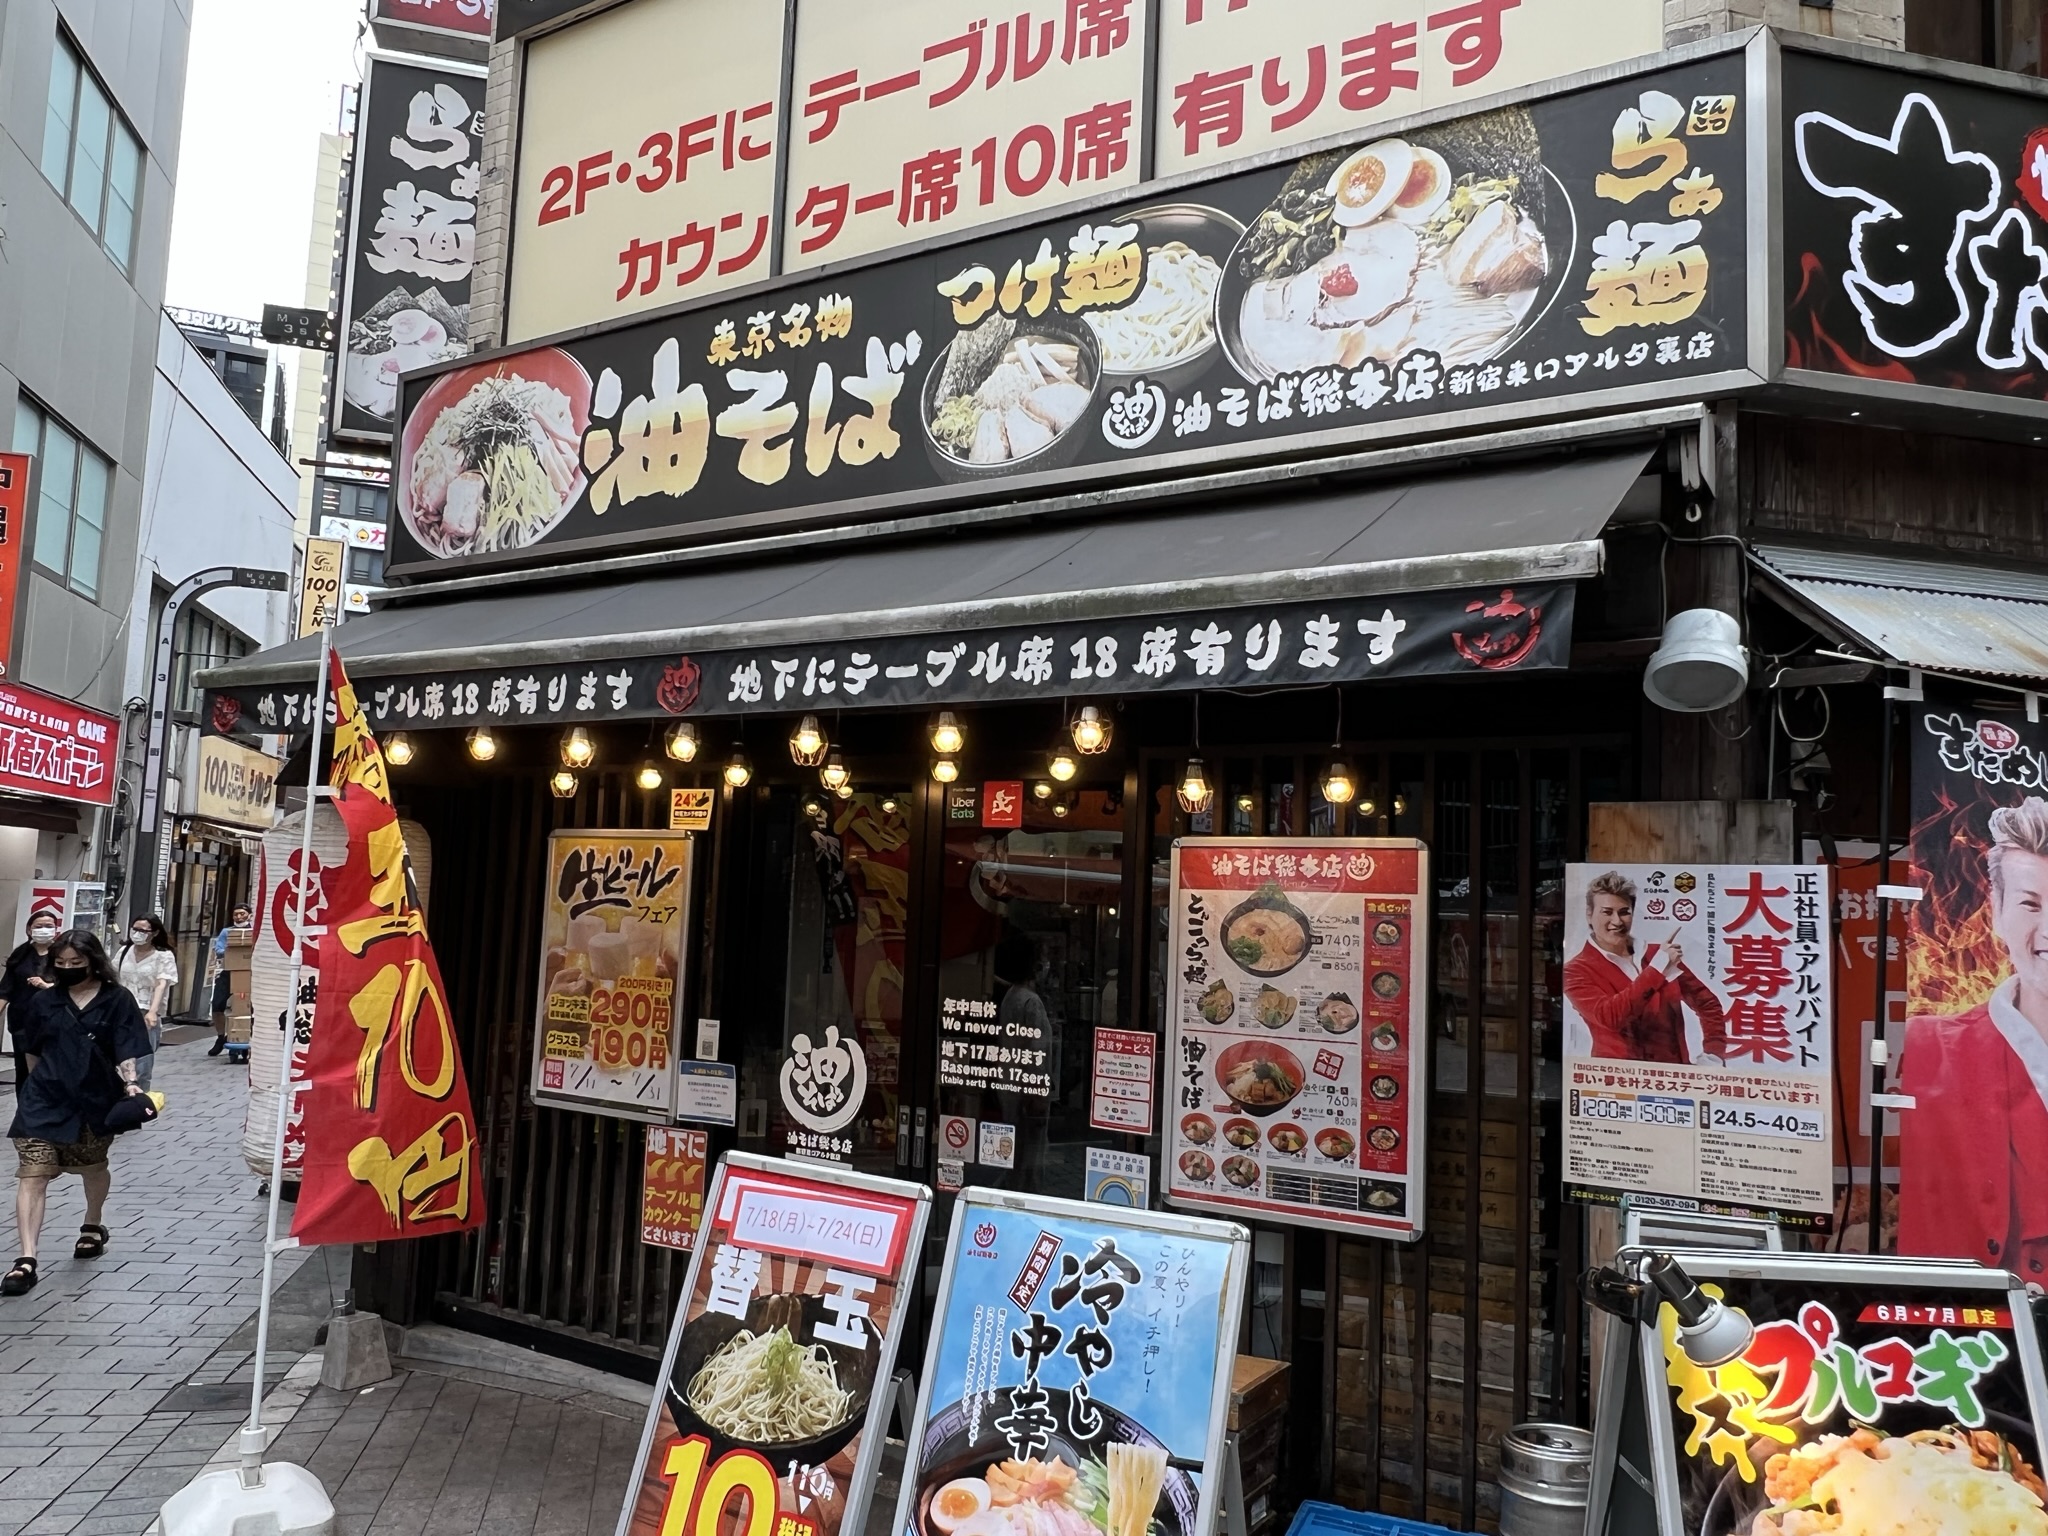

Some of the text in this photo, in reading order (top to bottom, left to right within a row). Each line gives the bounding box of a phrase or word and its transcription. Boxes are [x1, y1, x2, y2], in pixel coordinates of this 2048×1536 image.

[1578, 90, 1723, 336] らぁ麺
[937, 223, 1143, 325] つけ麺
[706, 293, 853, 366] 東京名物
[582, 329, 922, 515] 油そば
[1173, 352, 1435, 437] 油そば総本店
[306, 577, 337, 592] 100
[203, 755, 229, 799] 100
[951, 797, 975, 807] Uber
[951, 808, 975, 819] Eats
[558, 845, 680, 921] 生ビール
[1211, 853, 1343, 880] 油そば総本店
[636, 905, 678, 924] フェア
[1721, 871, 1794, 1064] 大募集
[1792, 872, 1823, 1068] 正社員・アルバイト
[942, 1016, 1042, 1039] We never Close
[943, 998, 997, 1018] 年中無休
[940, 1059, 1004, 1079] Basement
[1097, 1039, 1151, 1054] 決済サービス
[1181, 1036, 1208, 1110] 油そば
[648, 1127, 706, 1159] 地下に
[704, 1243, 885, 1352] 替玉
[1014, 1239, 1055, 1304] 期間限定
[1051, 1235, 1143, 1440] 冷やし
[1743, 1300, 2009, 1428] プルコギ
[994, 1312, 1064, 1464] 中華
